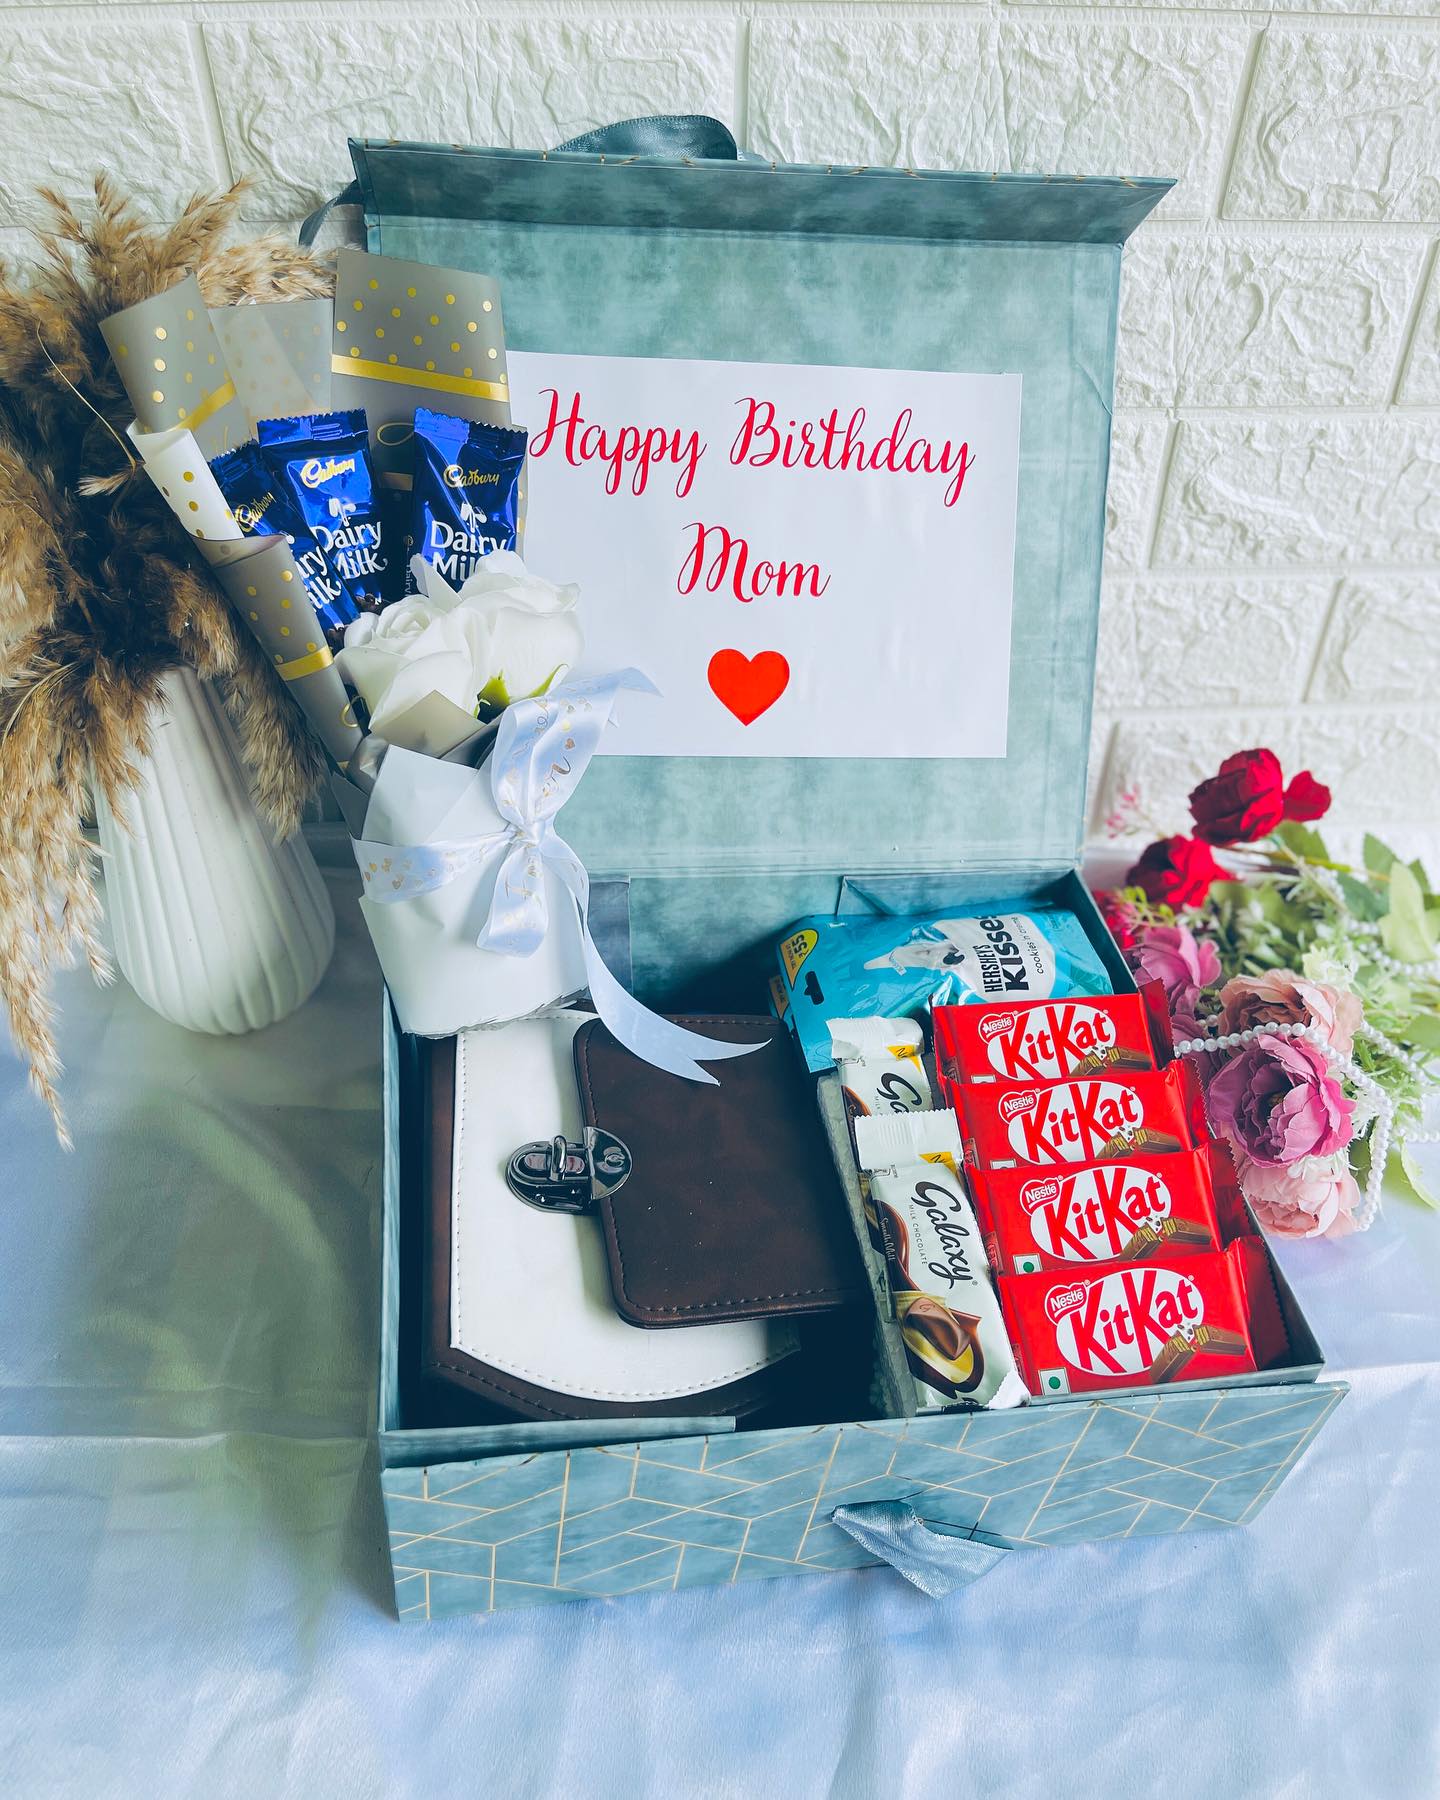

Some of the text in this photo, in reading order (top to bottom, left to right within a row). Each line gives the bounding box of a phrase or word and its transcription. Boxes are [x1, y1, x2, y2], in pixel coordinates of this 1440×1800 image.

[300, 458, 356, 489] Cadbury
[443, 464, 500, 488] Cadbury
[529, 388, 976, 508] Happy Birthday
[234, 492, 277, 533] Cadbury
[304, 577, 342, 613] ilk
[432, 551, 477, 581] Mil
[677, 522, 832, 603] Mom
[1027, 942, 1044, 975] cookies
[1000, 1005, 1112, 1080] KitKat
[1021, 1082, 1140, 1164] KitKat
[908, 1204, 929, 1266] MILK CHOCOLATE
[911, 1181, 973, 1290] Galaxy
[1043, 1167, 1166, 1260] KitKat
[1070, 1270, 1199, 1374] KitKat
